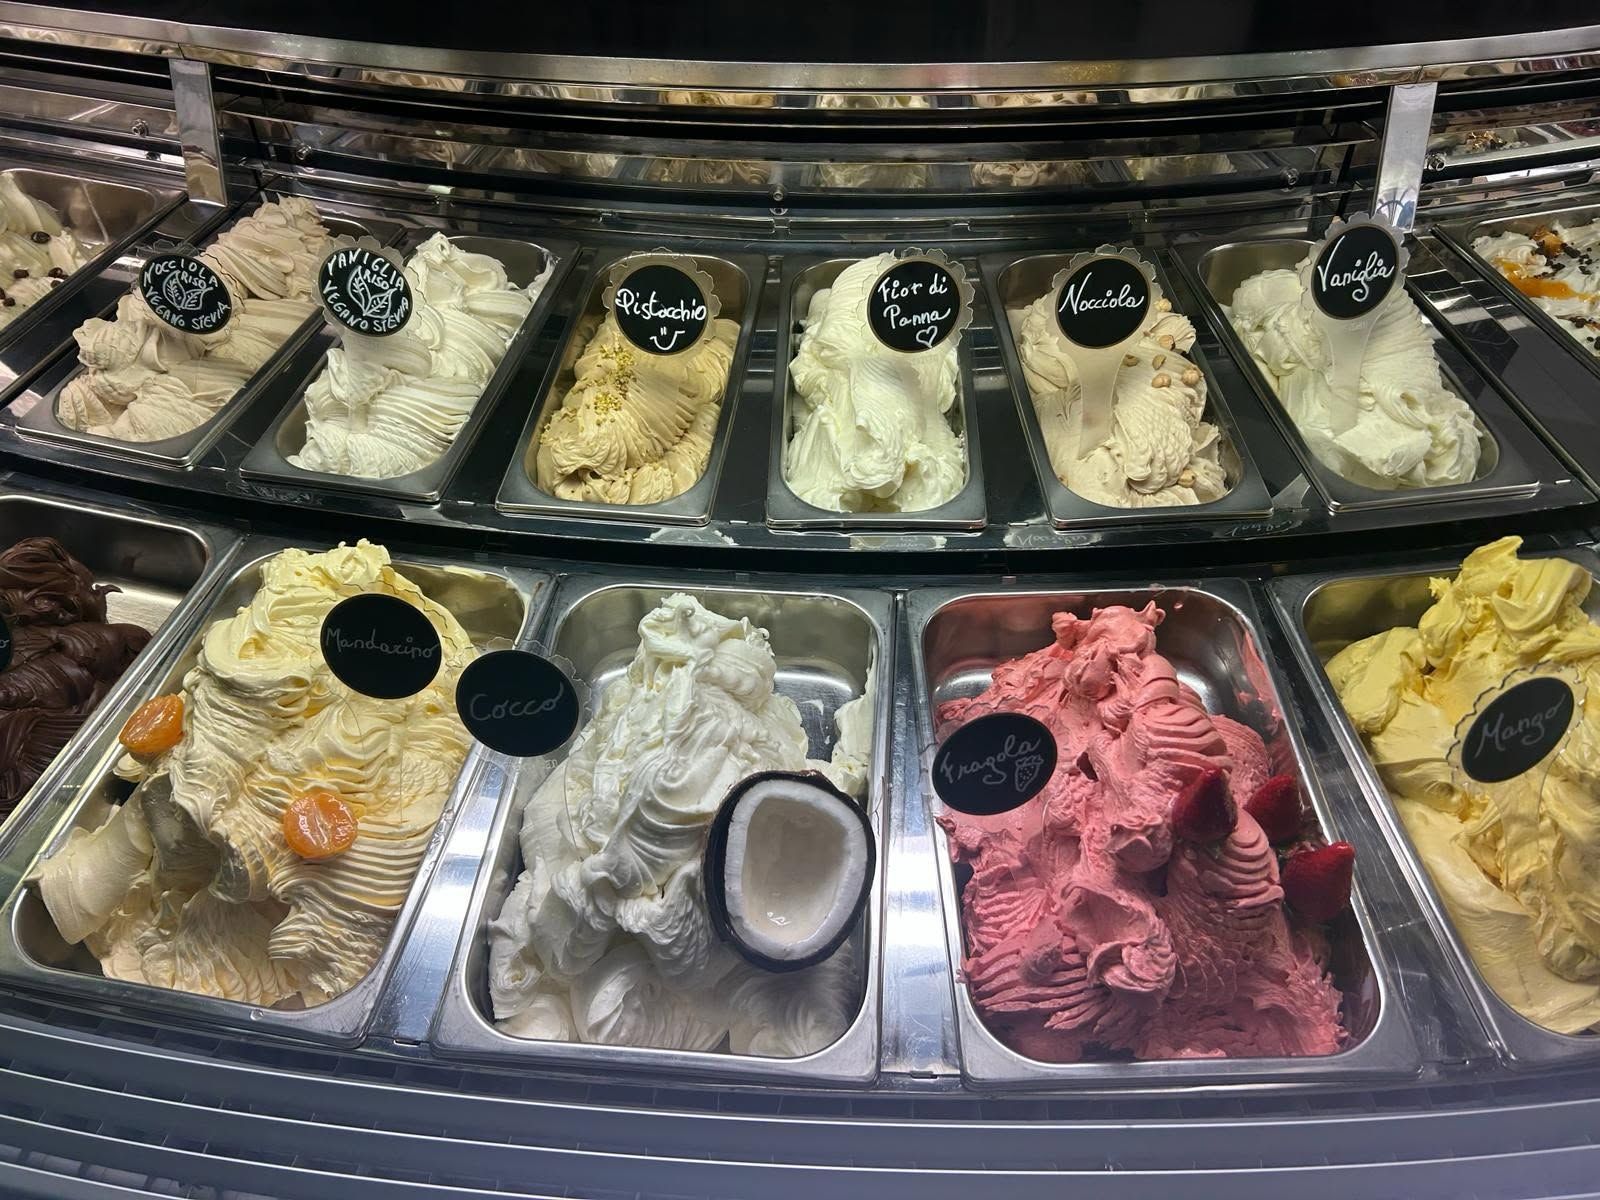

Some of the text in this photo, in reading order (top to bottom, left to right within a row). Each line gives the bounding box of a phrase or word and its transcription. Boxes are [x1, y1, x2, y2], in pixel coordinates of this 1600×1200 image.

[143, 258, 219, 288] NOCCIOLA
[181, 270, 207, 290] RISO
[327, 247, 405, 292] VANIGLIA
[363, 268, 390, 290] RISO
[877, 272, 948, 303] Fior di
[1316, 234, 1395, 303] Vaniglia
[145, 285, 232, 330] VEGANO STEVIA
[322, 279, 409, 332] VEGANO STEVIA
[614, 287, 707, 322] Pistacchio
[1058, 271, 1145, 315] Nocciola
[882, 304, 952, 330] Panna
[325, 626, 440, 659] Mandarino
[469, 680, 565, 721] Cocco
[1473, 692, 1567, 760] Mango
[940, 734, 1042, 785] Fragola
